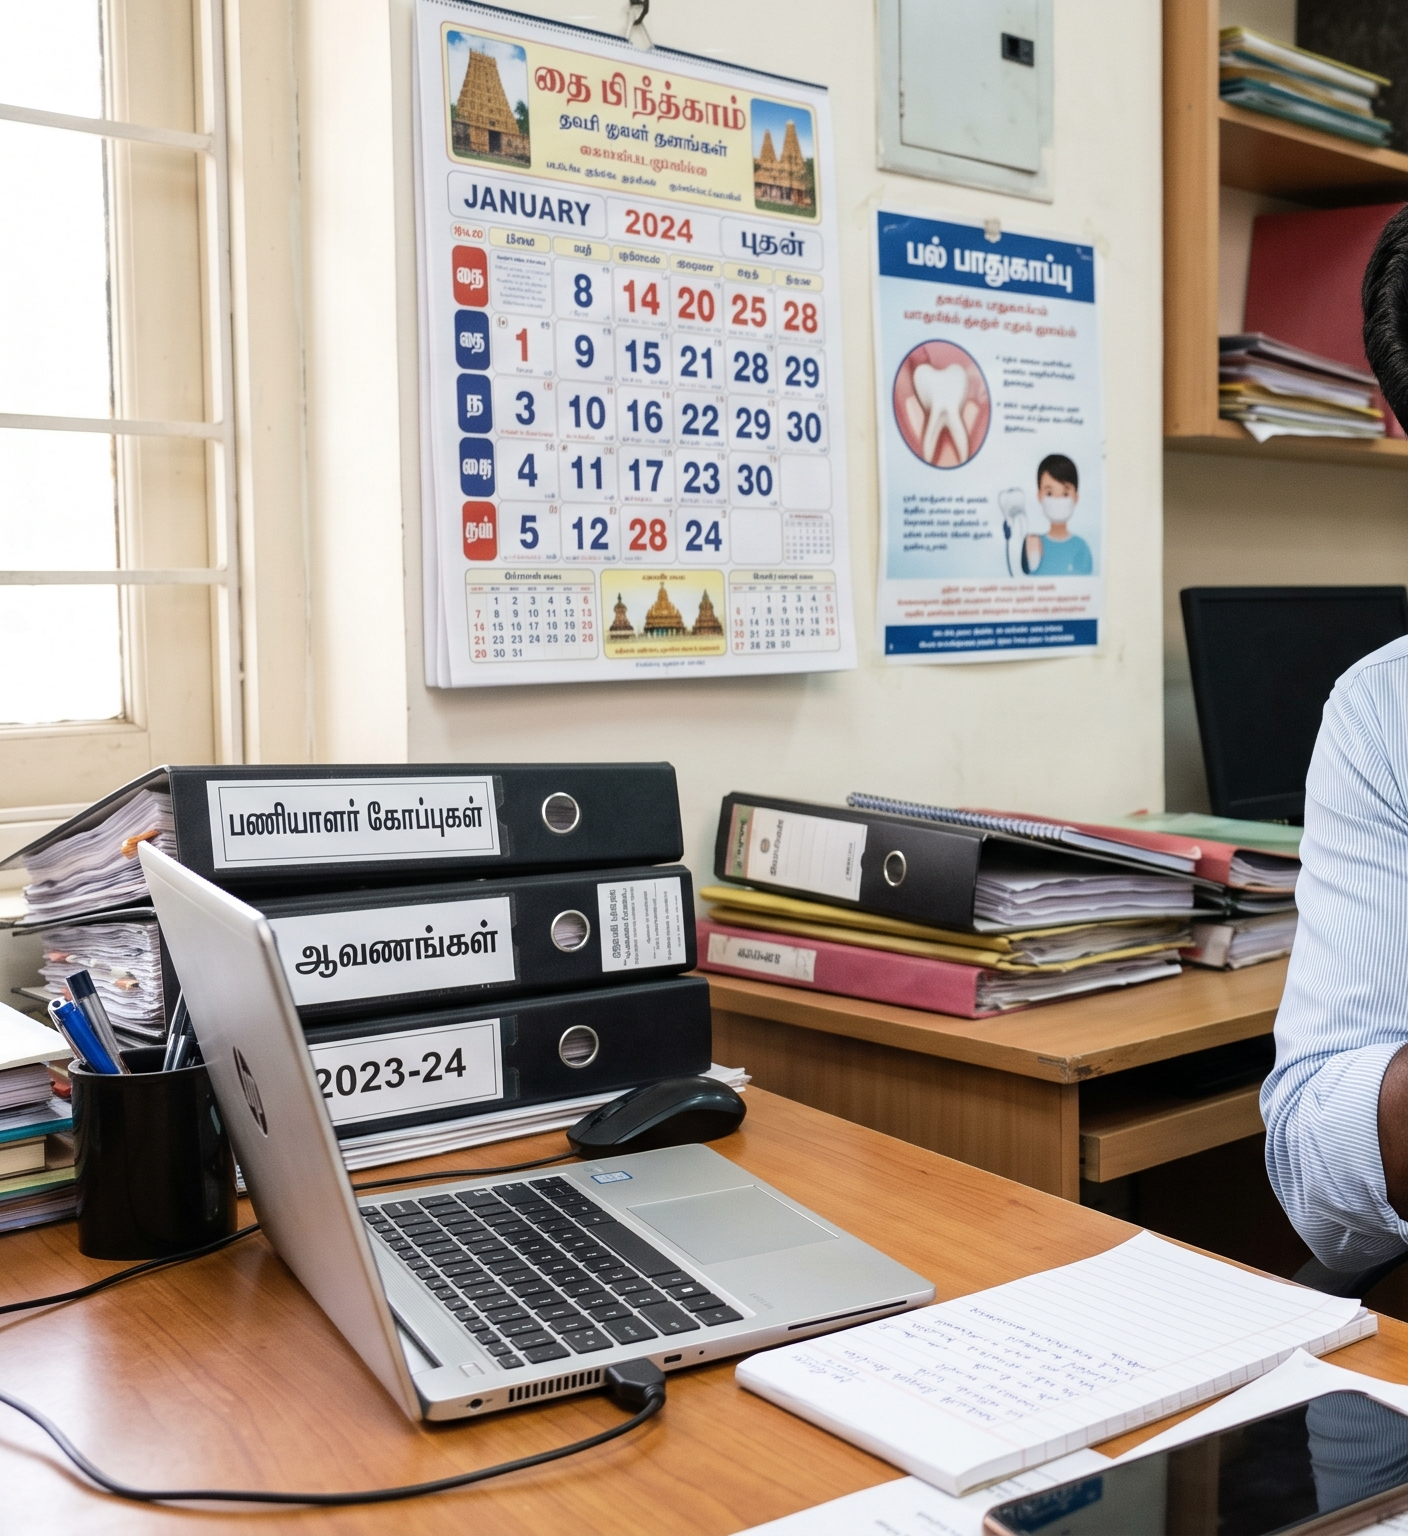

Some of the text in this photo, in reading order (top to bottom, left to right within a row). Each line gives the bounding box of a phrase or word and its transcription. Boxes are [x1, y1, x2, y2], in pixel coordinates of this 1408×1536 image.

[464, 184, 693, 243] JANUARY 2024
[741, 231, 805, 258] புதன்
[906, 236, 1073, 294] பல் பாதுகாப்பு
[574, 274, 593, 308] 8
[624, 280, 660, 315] 14
[678, 287, 714, 322] 20
[732, 294, 766, 327] 25
[784, 301, 817, 333] 28
[516, 328, 819, 388] 1 9 15 21 28 29
[516, 391, 821, 443] 3 10 16 22 29 30
[518, 454, 537, 487] 4
[572, 456, 602, 489] 11
[629, 459, 663, 491] 17
[684, 462, 720, 494] 23
[738, 464, 772, 496] 30
[520, 515, 722, 551] 5 12 28 24
[229, 795, 483, 837] பணியாளர் கோப்புகள்
[295, 919, 498, 978] ஆவணங்கள்
[315, 1047, 467, 1099] 2023-24
